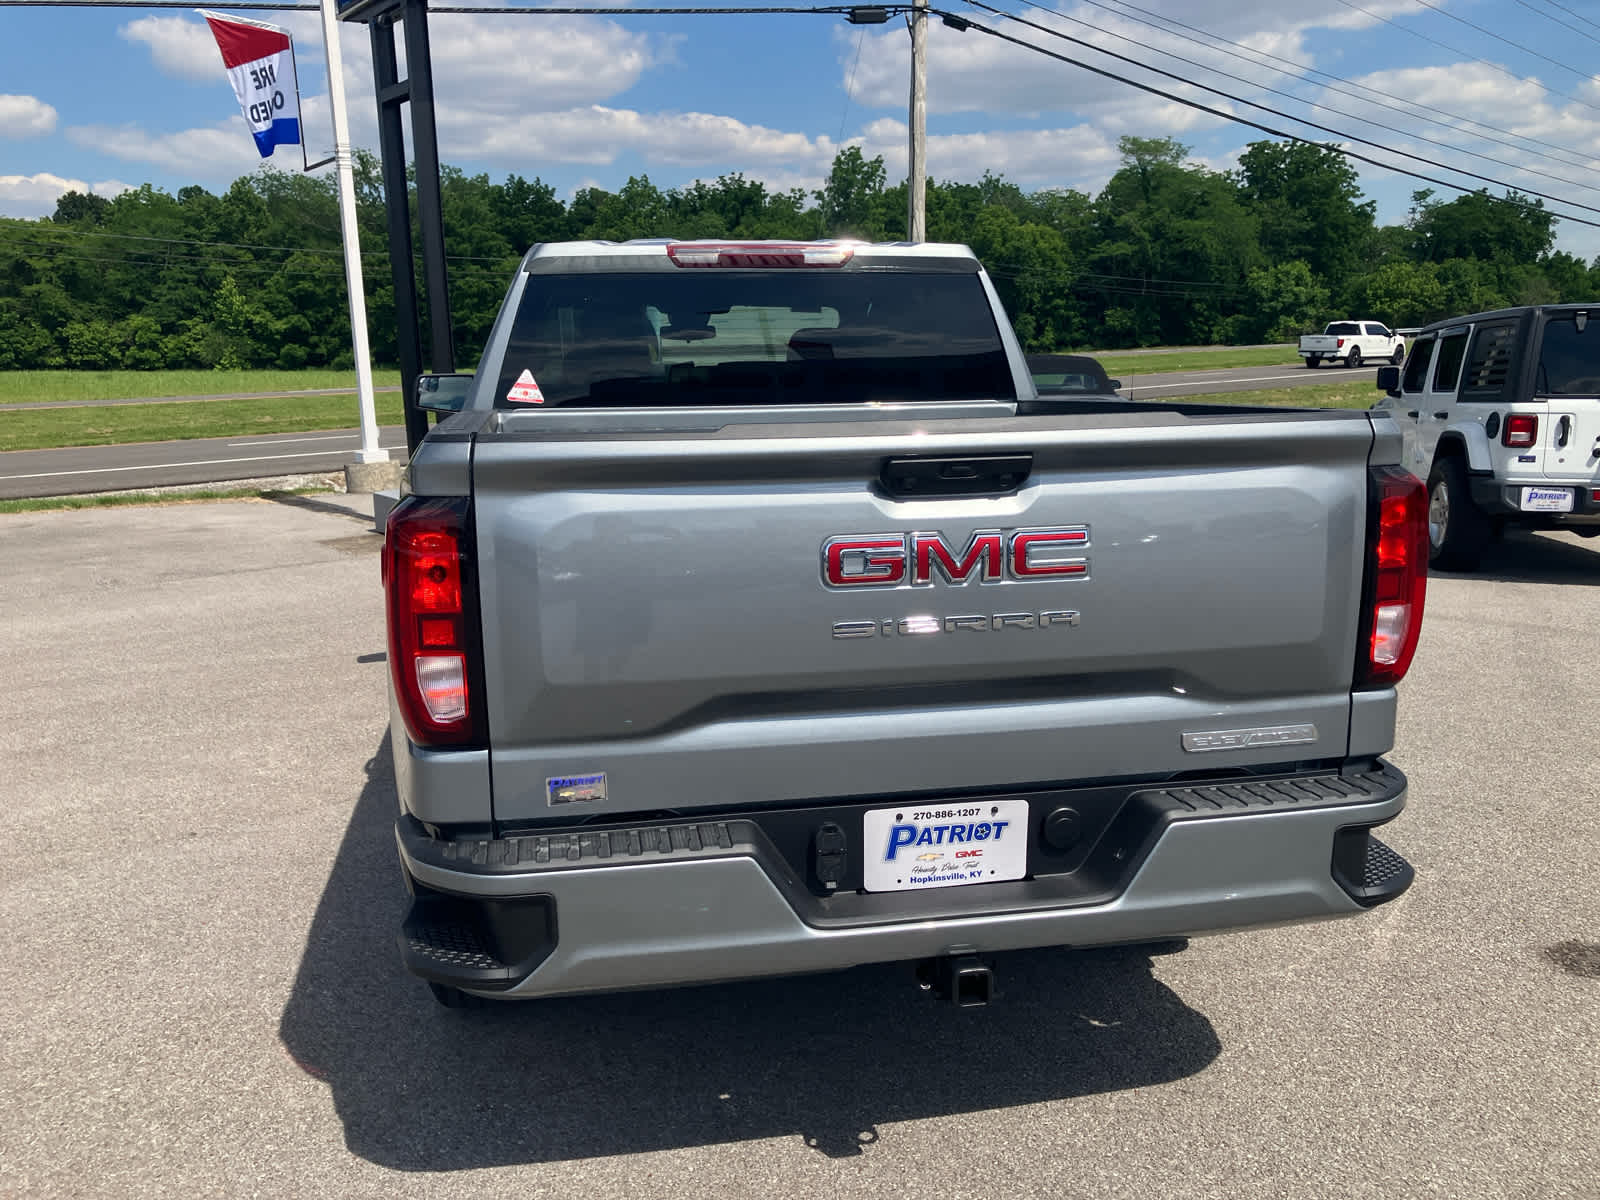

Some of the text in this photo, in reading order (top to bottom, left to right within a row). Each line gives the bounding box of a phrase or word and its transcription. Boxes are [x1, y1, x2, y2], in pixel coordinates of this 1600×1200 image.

[821, 525, 1090, 592] GMC
[832, 610, 1081, 639] SIERRA
[913, 808, 981, 821] 270-886-1207
[884, 821, 1009, 862] PATRIOT
[955, 849, 983, 859] GMC
[910, 870, 983, 884] Hopkinsville, KY
